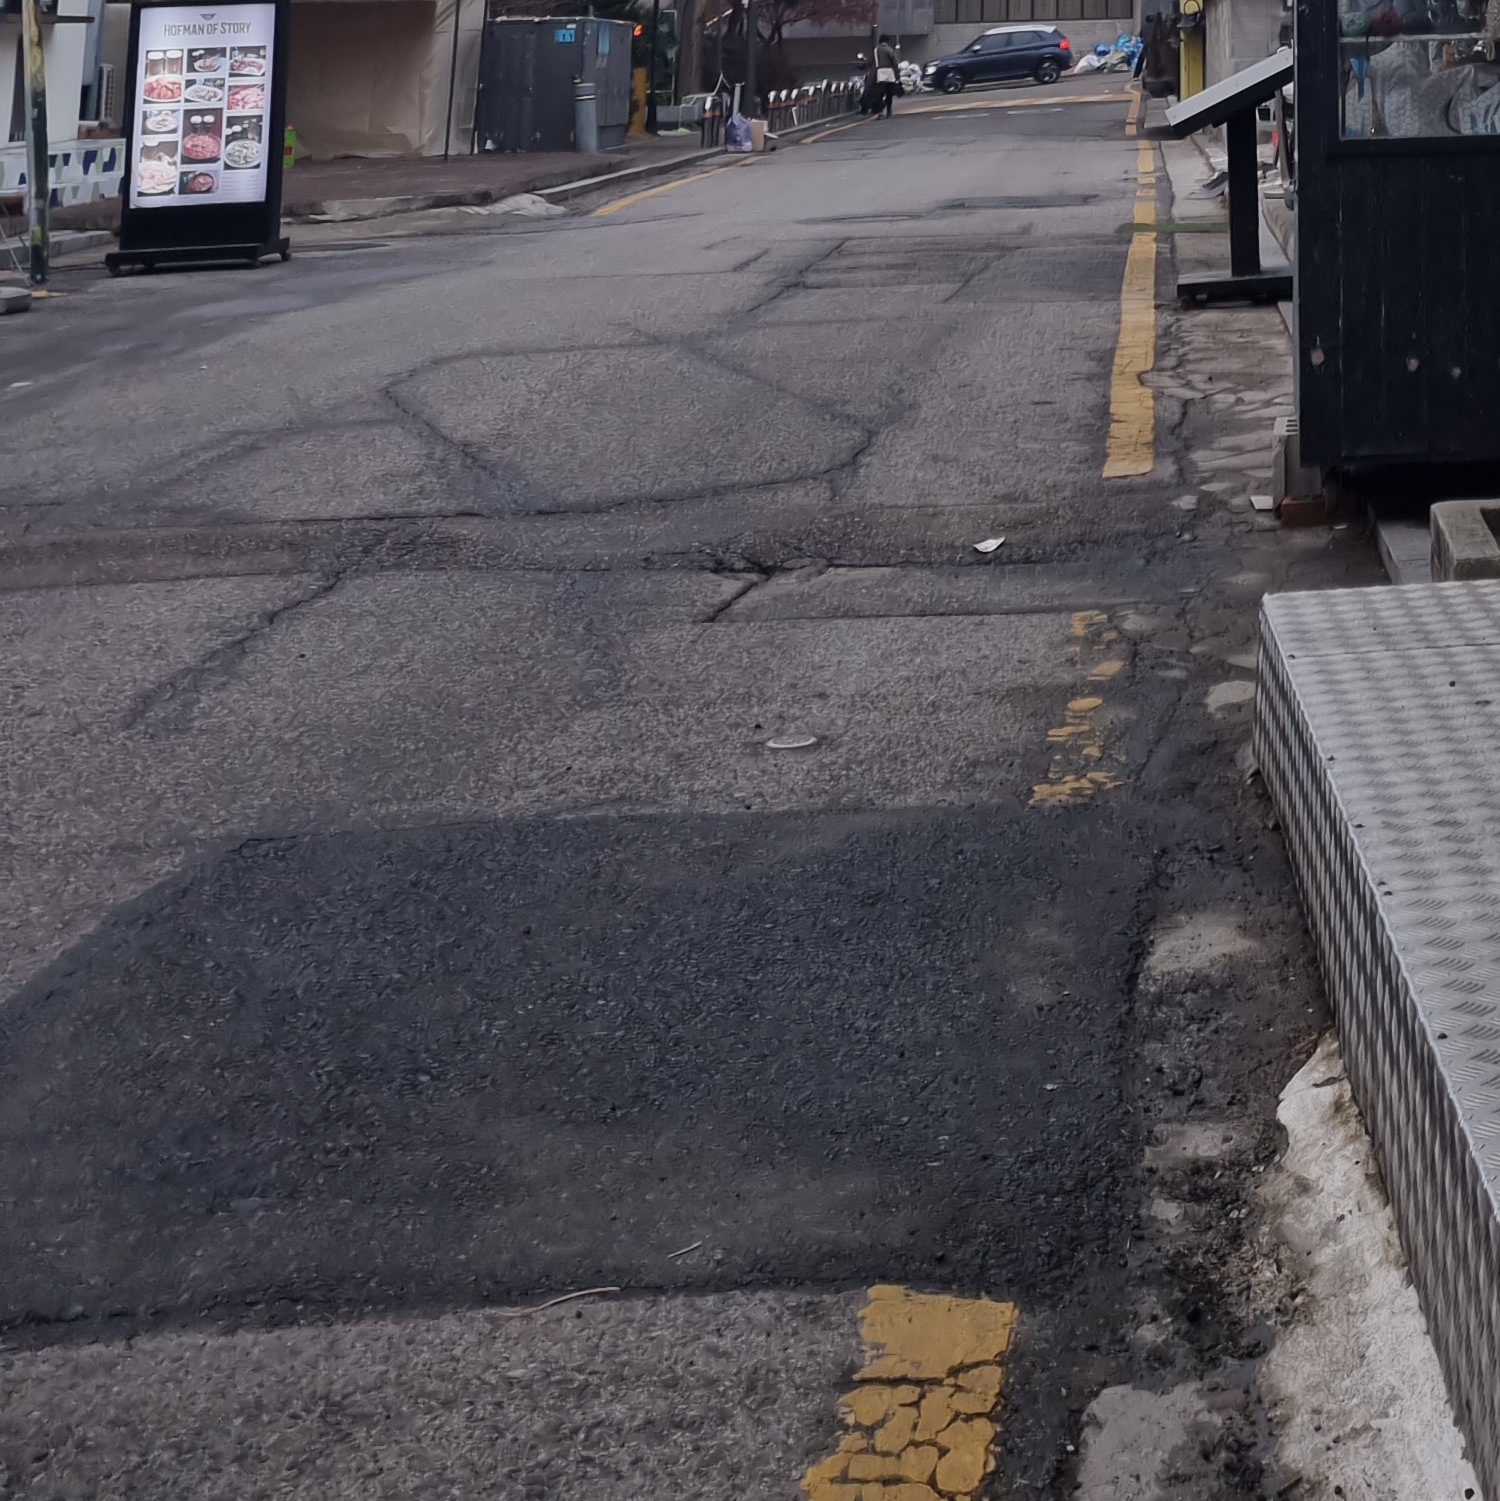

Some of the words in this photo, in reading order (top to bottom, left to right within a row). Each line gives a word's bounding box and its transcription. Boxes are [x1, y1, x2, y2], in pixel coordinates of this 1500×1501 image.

[163, 23, 205, 37] HOFMAN
[207, 23, 218, 35] OF
[220, 21, 251, 34] STORY
